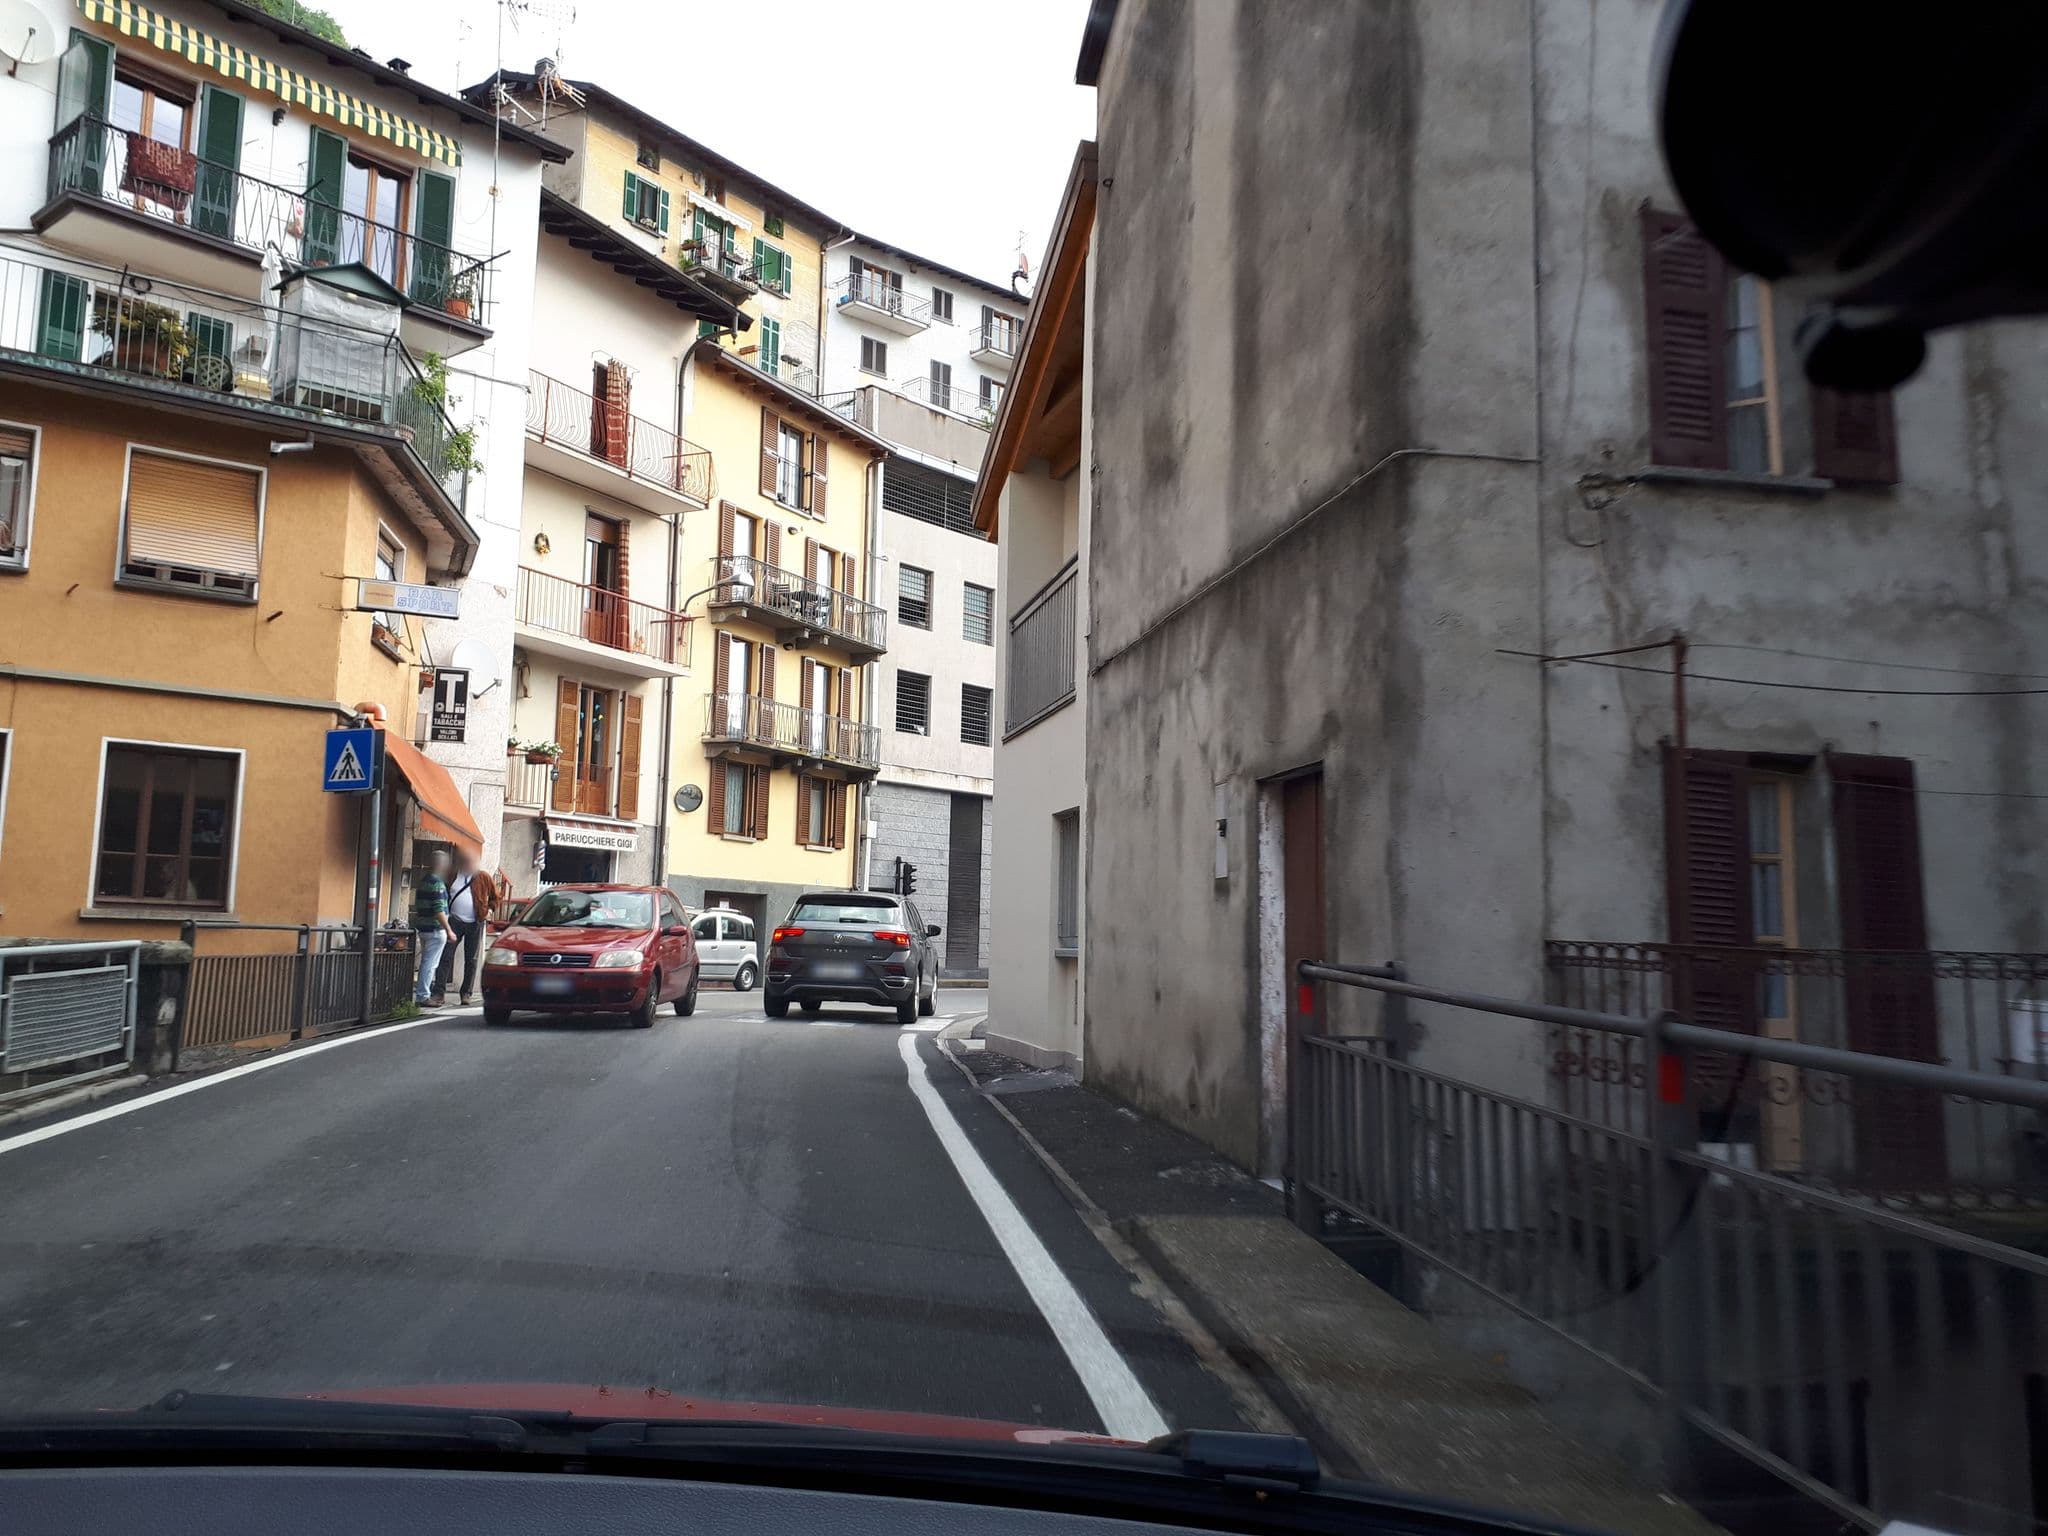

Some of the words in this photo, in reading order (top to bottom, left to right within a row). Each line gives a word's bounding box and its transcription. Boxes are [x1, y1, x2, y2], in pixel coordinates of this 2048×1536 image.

[408, 588, 443, 600] BAR
[397, 597, 453, 611] SPORT
[440, 673, 465, 713] T
[434, 718, 465, 726] TABACCHI
[555, 832, 616, 848] PARRUCCHIERE
[617, 838, 633, 849] GIGI
